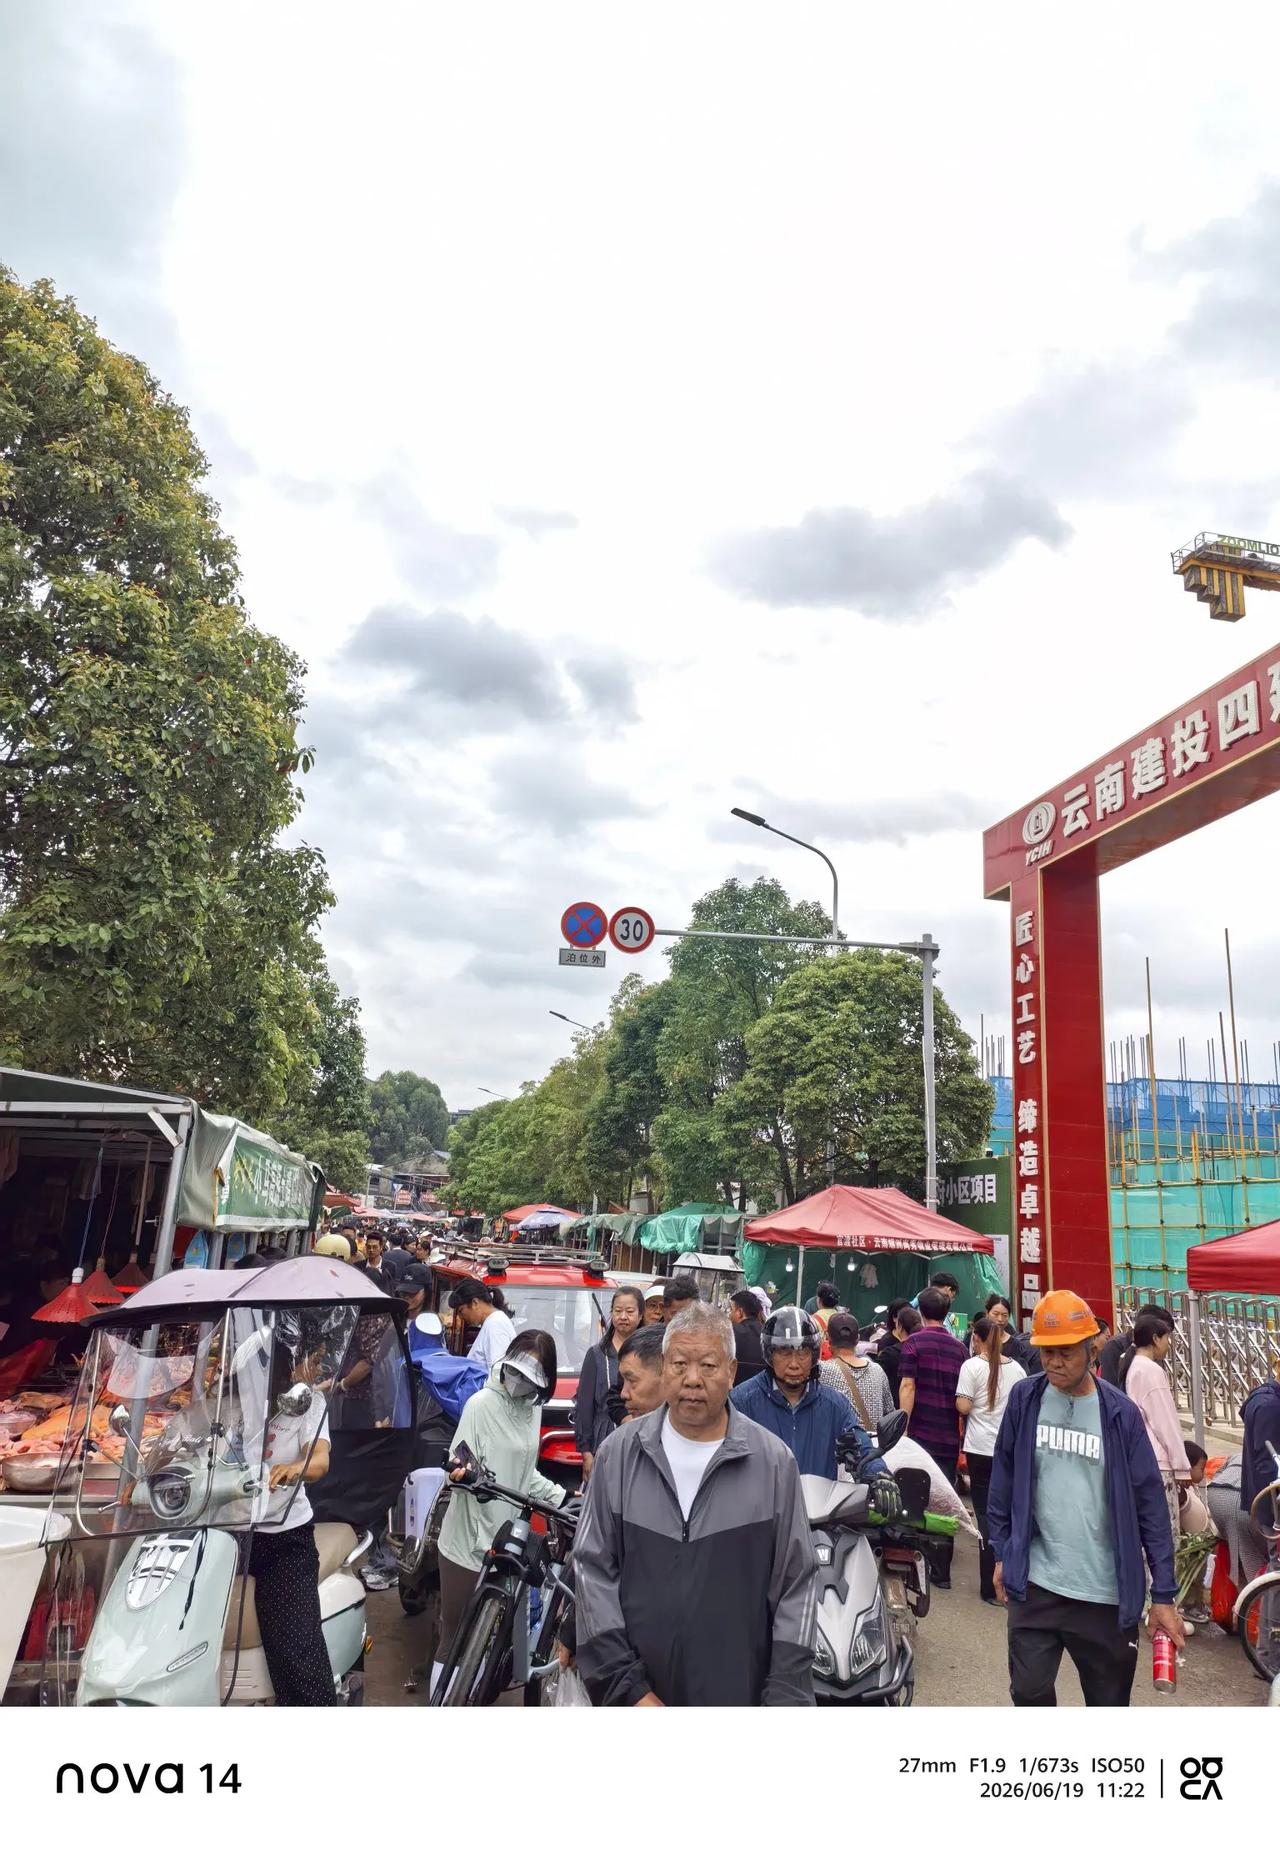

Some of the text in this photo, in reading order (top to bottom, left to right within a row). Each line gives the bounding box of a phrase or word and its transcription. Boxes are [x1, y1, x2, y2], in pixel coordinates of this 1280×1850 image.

[1025, 840, 1054, 866] YCIH
[620, 919, 643, 941] 30
[566, 952, 601, 965] 泊位外
[1015, 911, 1036, 1064] 匠心工艺
[1036, 1424, 1100, 1459] PUMA
